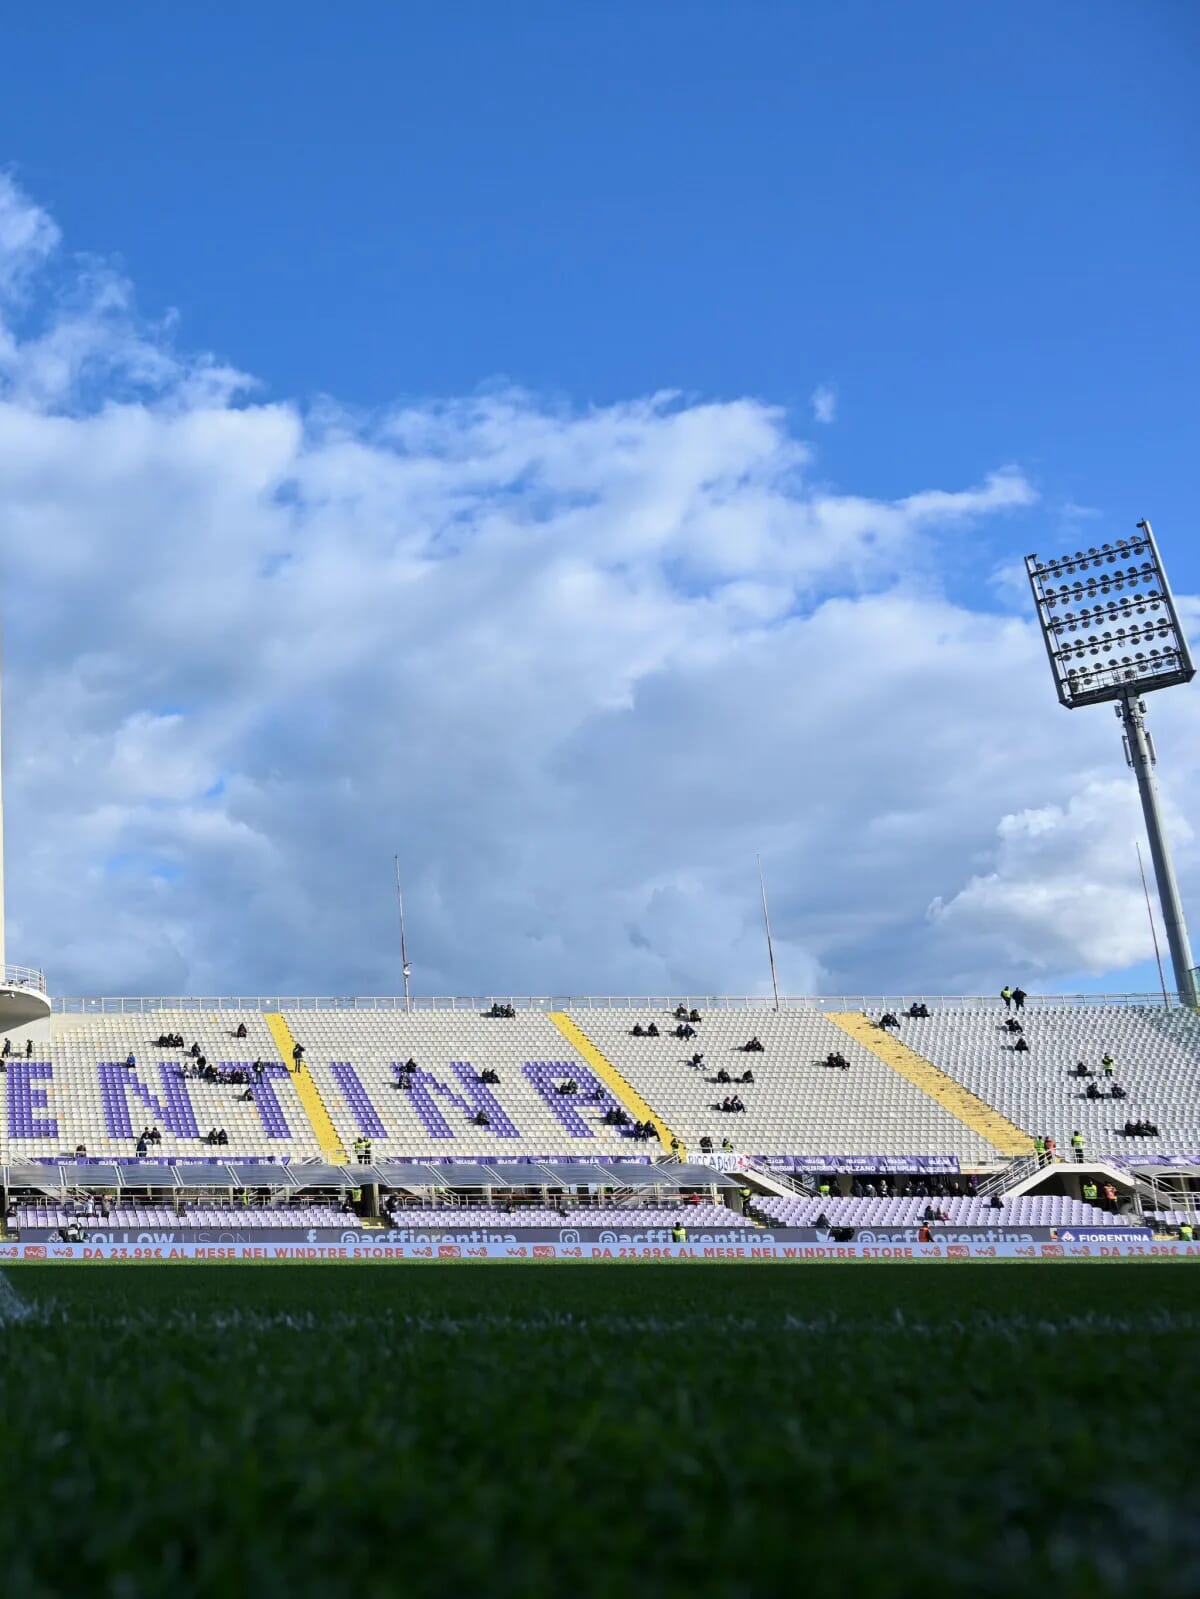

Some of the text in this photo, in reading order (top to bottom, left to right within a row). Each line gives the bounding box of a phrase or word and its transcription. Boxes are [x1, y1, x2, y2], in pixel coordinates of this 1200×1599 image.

[85, 1232, 175, 1243] OLLOW
[340, 1229, 517, 1243] @acffiorentina
[598, 1229, 776, 1243] @acffirentina
[1078, 1234, 1150, 1242] FIORENTINA
[83, 1248, 103, 1258] DA
[110, 1248, 162, 1258] 23.99€
[169, 1248, 187, 1258] AL
[195, 1248, 236, 1258] MESE
[242, 1248, 268, 1258] NEI
[275, 1248, 347, 1258] WINDTRE
[354, 1248, 403, 1258] STORE
[592, 1248, 612, 1258] DA
[619, 1248, 671, 1258] 23.99€
[678, 1248, 697, 1258] AL
[704, 1248, 745, 1258] MESE
[752, 1248, 777, 1258] NEI
[783, 1248, 855, 1258] WINDTRE
[863, 1248, 912, 1258] STORE
[1101, 1247, 1121, 1256] DA
